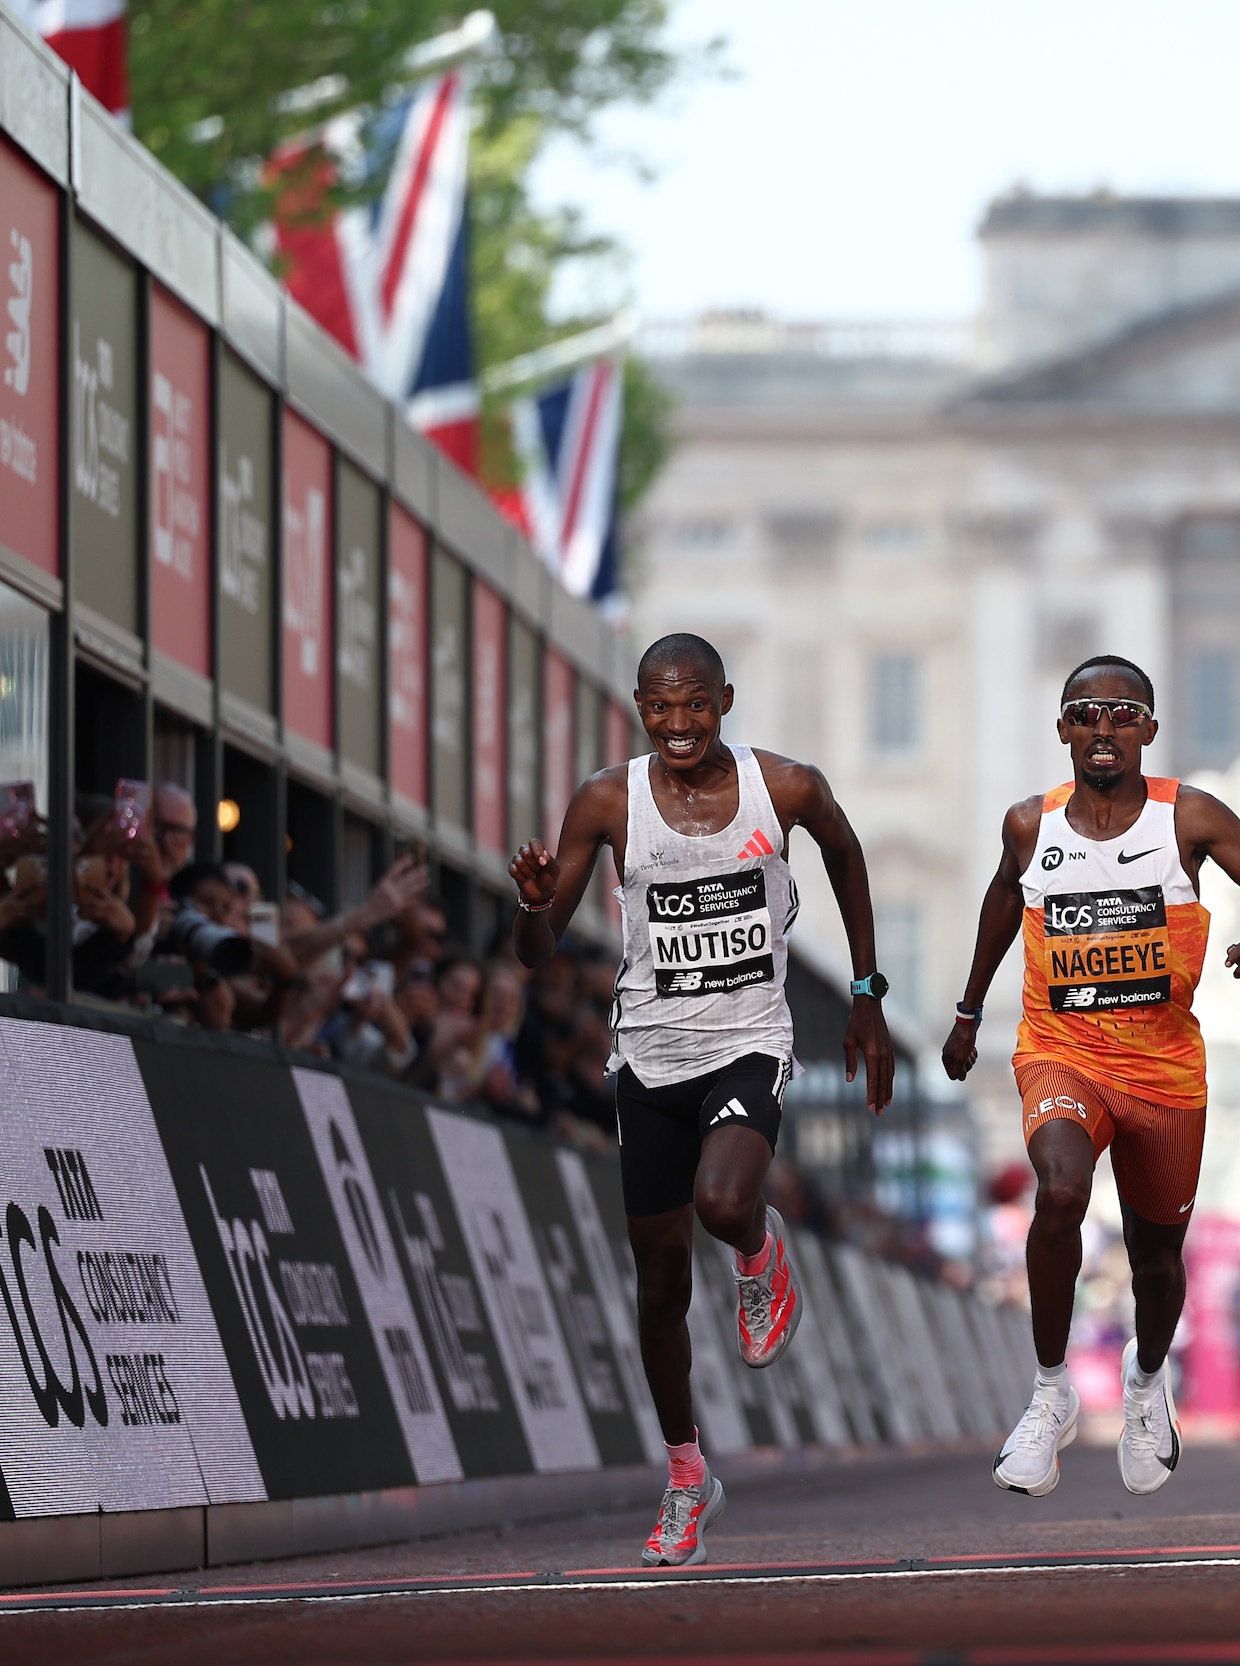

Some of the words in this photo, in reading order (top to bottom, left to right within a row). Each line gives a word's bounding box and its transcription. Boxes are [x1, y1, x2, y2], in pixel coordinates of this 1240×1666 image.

[1068, 851, 1086, 861] NN
[697, 883, 724, 893] TATA
[698, 885, 757, 904] CONSULTANCY
[653, 891, 695, 916] tcs
[699, 899, 739, 913] SERVICES
[1096, 897, 1123, 907] TATA
[1097, 902, 1156, 917] CONSULTANCY
[1051, 902, 1093, 929] tcs
[1097, 915, 1137, 926] SERVICES
[656, 923, 766, 963] MUTISO
[1051, 941, 1166, 978] NAGEEYE
[704, 980, 725, 989] new
[727, 970, 763, 987] balance
[1098, 996, 1119, 1005] new
[1120, 991, 1161, 1003] balance
[1025, 1095, 1087, 1132] INEOS
[44, 1149, 104, 1221] TATA
[77, 1250, 181, 1324] CONSULTANCY
[198, 1161, 316, 1421] tcs
[106, 1354, 182, 1426] SERVICES
